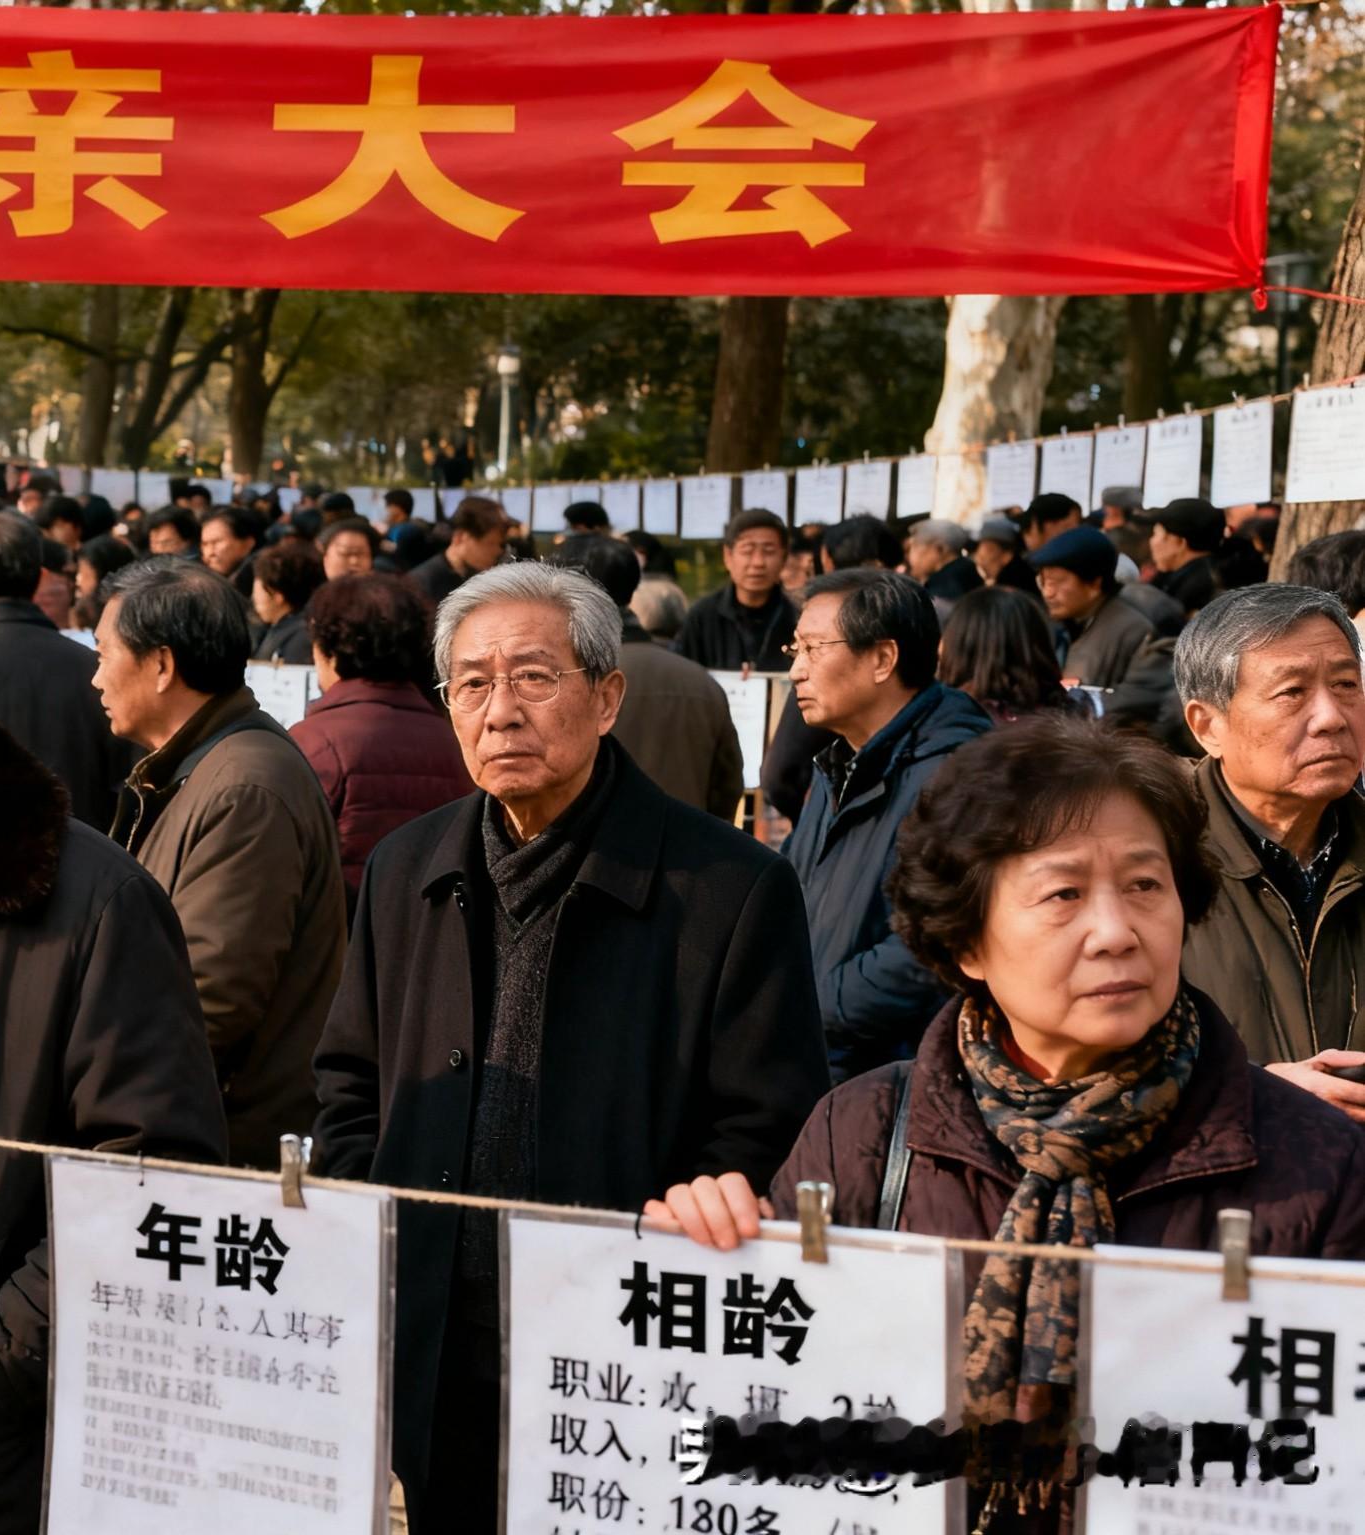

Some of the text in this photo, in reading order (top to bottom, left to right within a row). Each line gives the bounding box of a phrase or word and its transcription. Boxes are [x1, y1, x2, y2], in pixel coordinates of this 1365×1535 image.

[135, 1202, 291, 1296] 年龄
[618, 1260, 816, 1366] 相龄
[1228, 1316, 1365, 1416] 相
